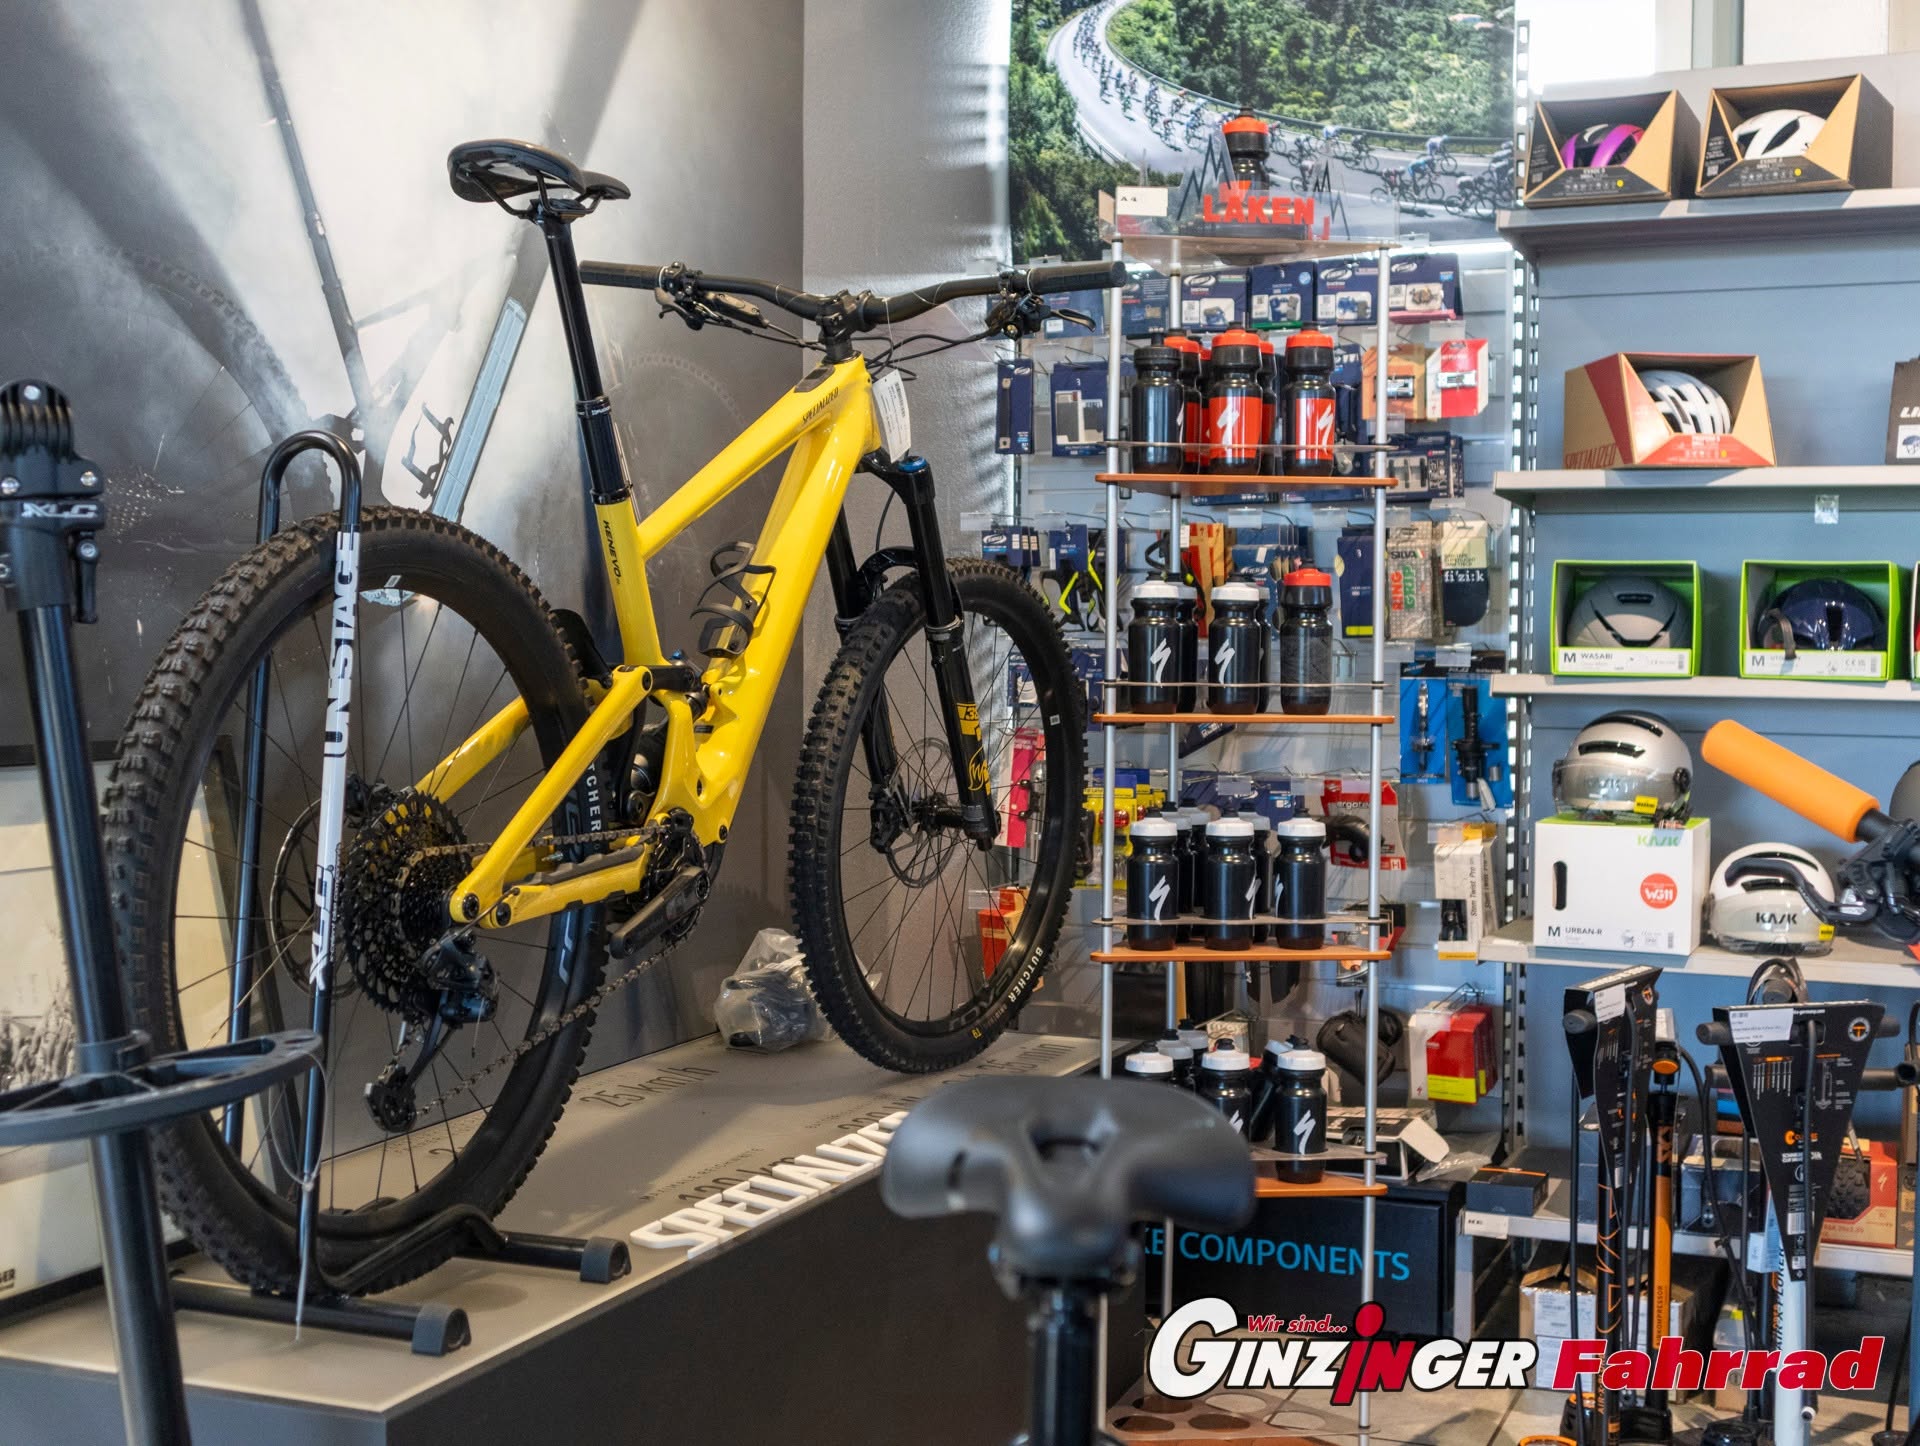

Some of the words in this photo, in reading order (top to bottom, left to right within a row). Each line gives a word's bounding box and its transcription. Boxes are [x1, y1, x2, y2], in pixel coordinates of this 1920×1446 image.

[1203, 193, 1315, 225] LAKEN
[802, 387, 839, 424] SPECIALIZED
[21, 502, 98, 518] XLC
[603, 520, 621, 578] KENEVO
[1390, 550, 1418, 559] SILVA
[1390, 570, 1404, 611] RING
[1402, 564, 1416, 609] GRIP
[1563, 652, 1576, 663] M
[1580, 652, 1613, 660] WASABI
[1751, 655, 1765, 667] M
[584, 762, 602, 832] TCHER
[1637, 834, 1681, 847] KASK
[1548, 925, 1561, 937] M
[1565, 927, 1603, 936] URBAN-R
[1756, 912, 1797, 924] KASK
[1007, 947, 1043, 1003] BUTCHER
[617, 1067, 720, 1093] km/h
[1180, 1231, 1410, 1281] COMPONENTS
